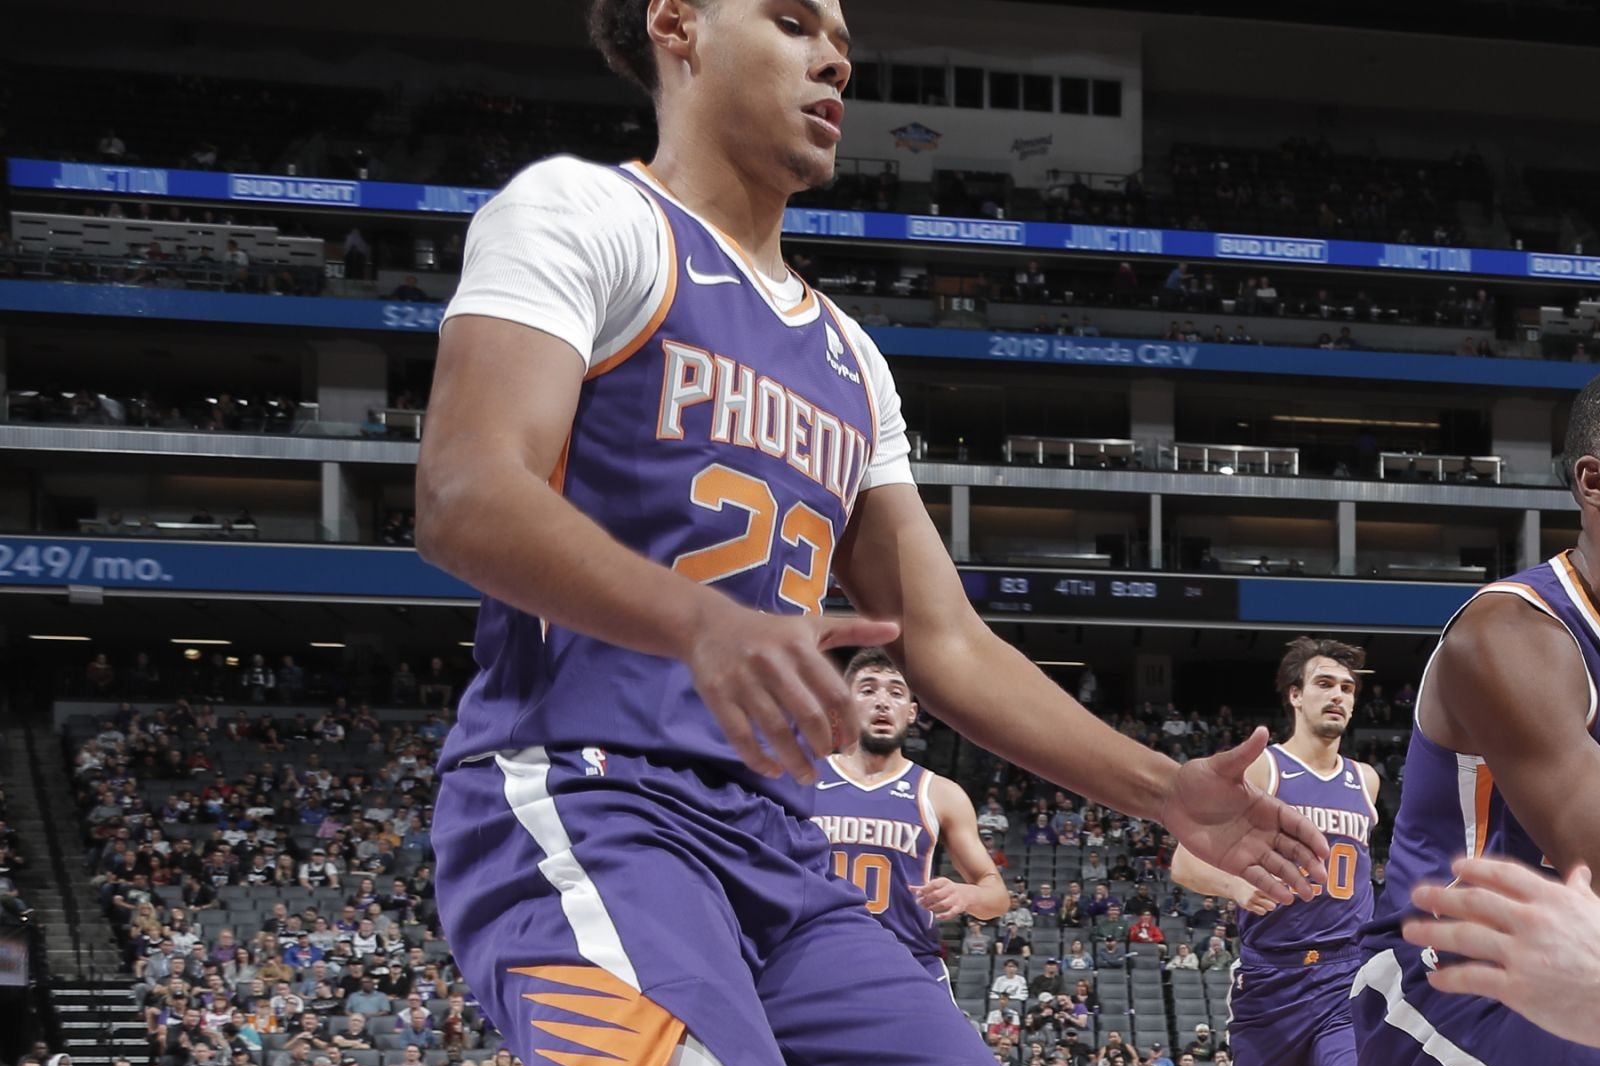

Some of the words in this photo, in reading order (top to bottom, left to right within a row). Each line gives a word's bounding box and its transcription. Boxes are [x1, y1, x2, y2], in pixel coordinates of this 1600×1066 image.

[235, 176, 282, 199] BUD
[285, 179, 357, 203] LIGHT
[782, 207, 865, 237] UNCTION
[911, 220, 954, 237] BUD
[959, 223, 1020, 242] LIGHT
[1220, 238, 1261, 255] BUD
[1264, 241, 1323, 259] LIGHT
[1533, 257, 1572, 274] BUD
[989, 336, 1049, 358] 2019
[1053, 340, 1135, 363] Honda
[1137, 343, 1198, 366] CR-V
[826, 349, 860, 385] PayPal
[671, 463, 835, 617] 23
[1054, 579, 1096, 596] 4TH
[1289, 805, 1370, 848] HOENIX
